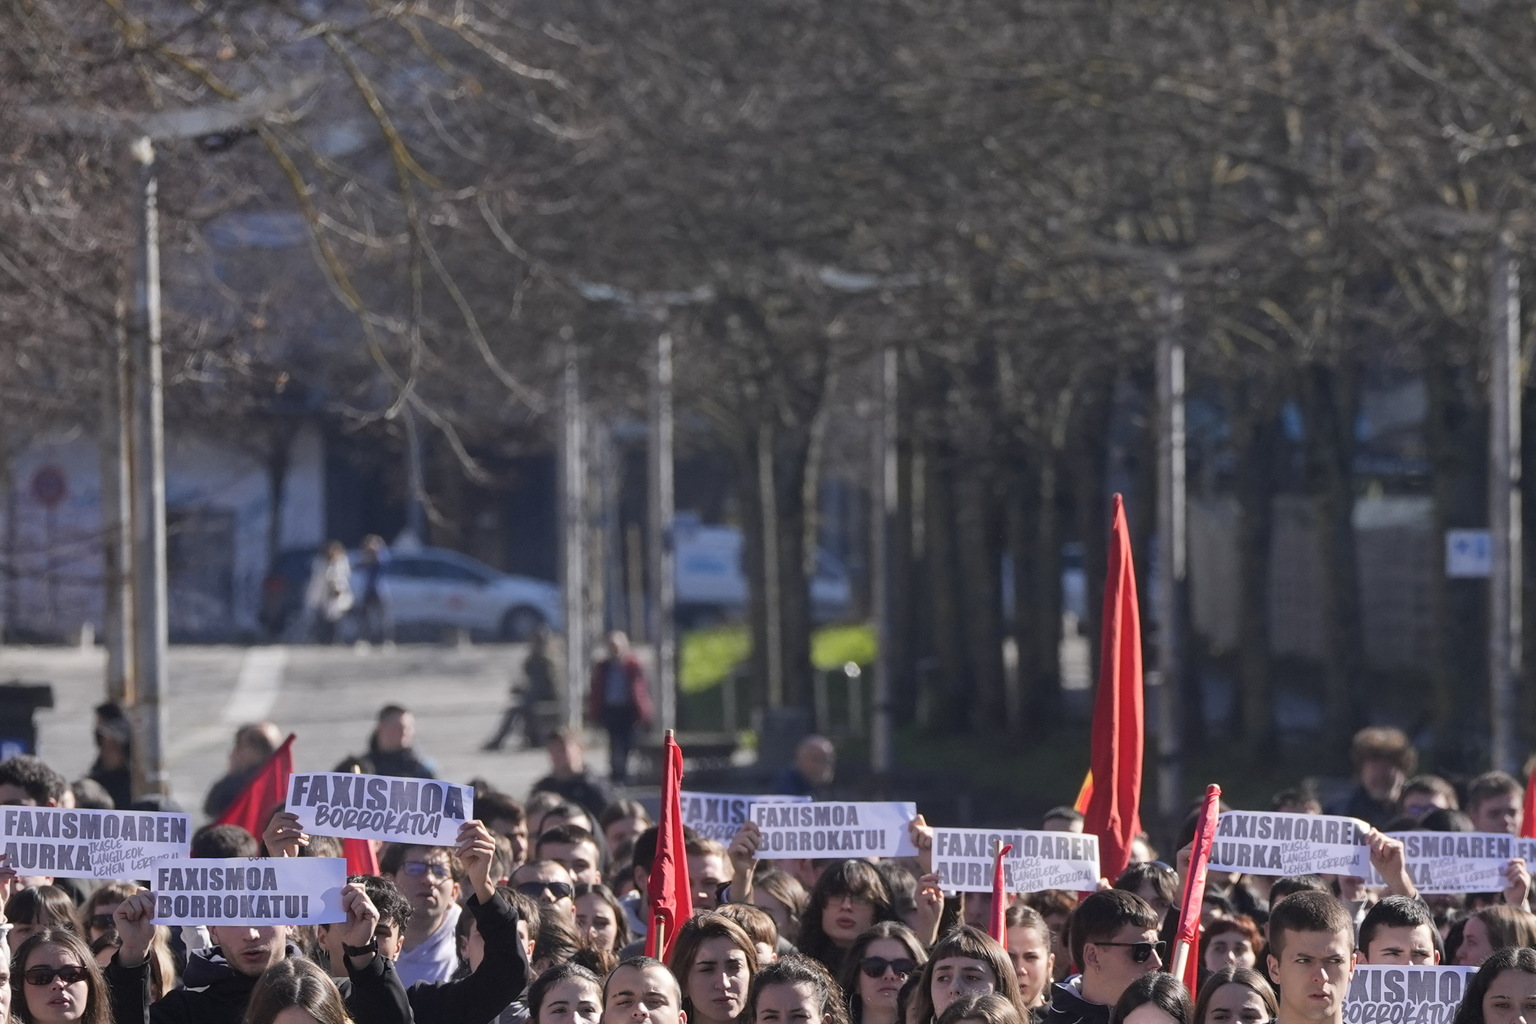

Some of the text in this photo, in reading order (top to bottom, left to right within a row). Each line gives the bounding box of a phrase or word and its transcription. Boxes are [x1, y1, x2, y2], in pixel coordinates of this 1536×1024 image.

[292, 775, 465, 820] FAXISMOA
[5, 810, 187, 843] FAXISMOAREN
[315, 804, 442, 838] BORROKATU!
[757, 805, 859, 828] FAXISMOA
[759, 829, 886, 851] BORROKATU!
[1217, 815, 1367, 847] AXISMOAREN
[5, 842, 92, 871] AURKA
[89, 838, 122, 855] IKASLE
[91, 847, 144, 865] LANGILEOK
[1208, 842, 1282, 869] AURKA
[1403, 836, 1510, 858] SMOAREN
[93, 863, 125, 877] LEHEN
[1011, 857, 1042, 875] IKASLE
[158, 867, 278, 891] FAXISMOA
[1015, 880, 1044, 893] LEHEN
[157, 895, 309, 918] BORROKATU!
[1346, 970, 1477, 1005] XISMO
